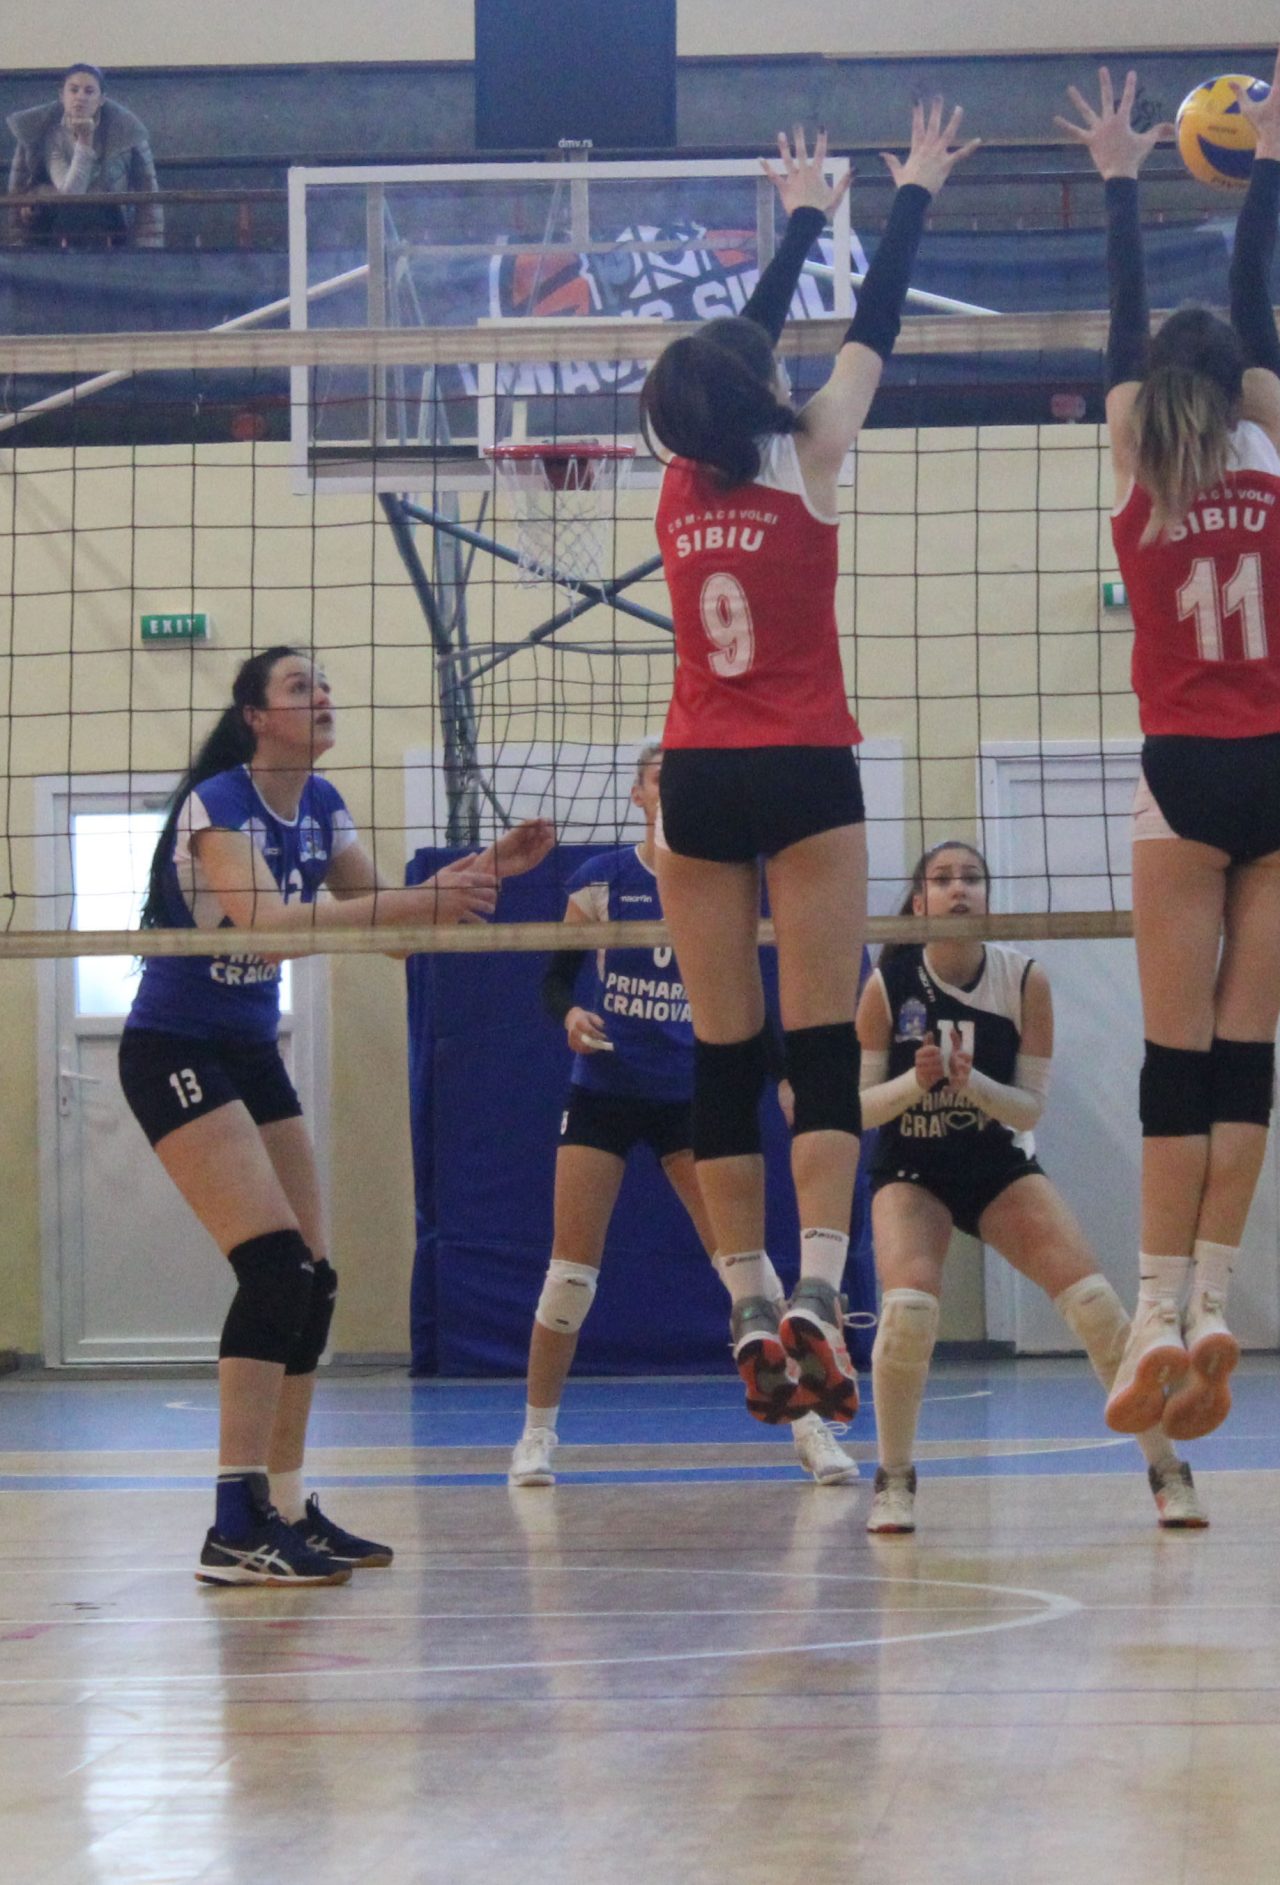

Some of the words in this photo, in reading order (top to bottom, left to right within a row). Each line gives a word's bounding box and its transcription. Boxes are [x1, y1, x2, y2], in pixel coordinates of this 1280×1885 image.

[739, 510, 779, 525] VOLEI
[1167, 505, 1268, 542] SIBIU
[675, 525, 765, 559] SIBIU
[700, 571, 756, 678] 9
[1175, 552, 1270, 663] 11
[150, 619, 196, 634] EXIT
[603, 993, 693, 1022] CRAIOVA
[169, 1068, 203, 1108] 13
